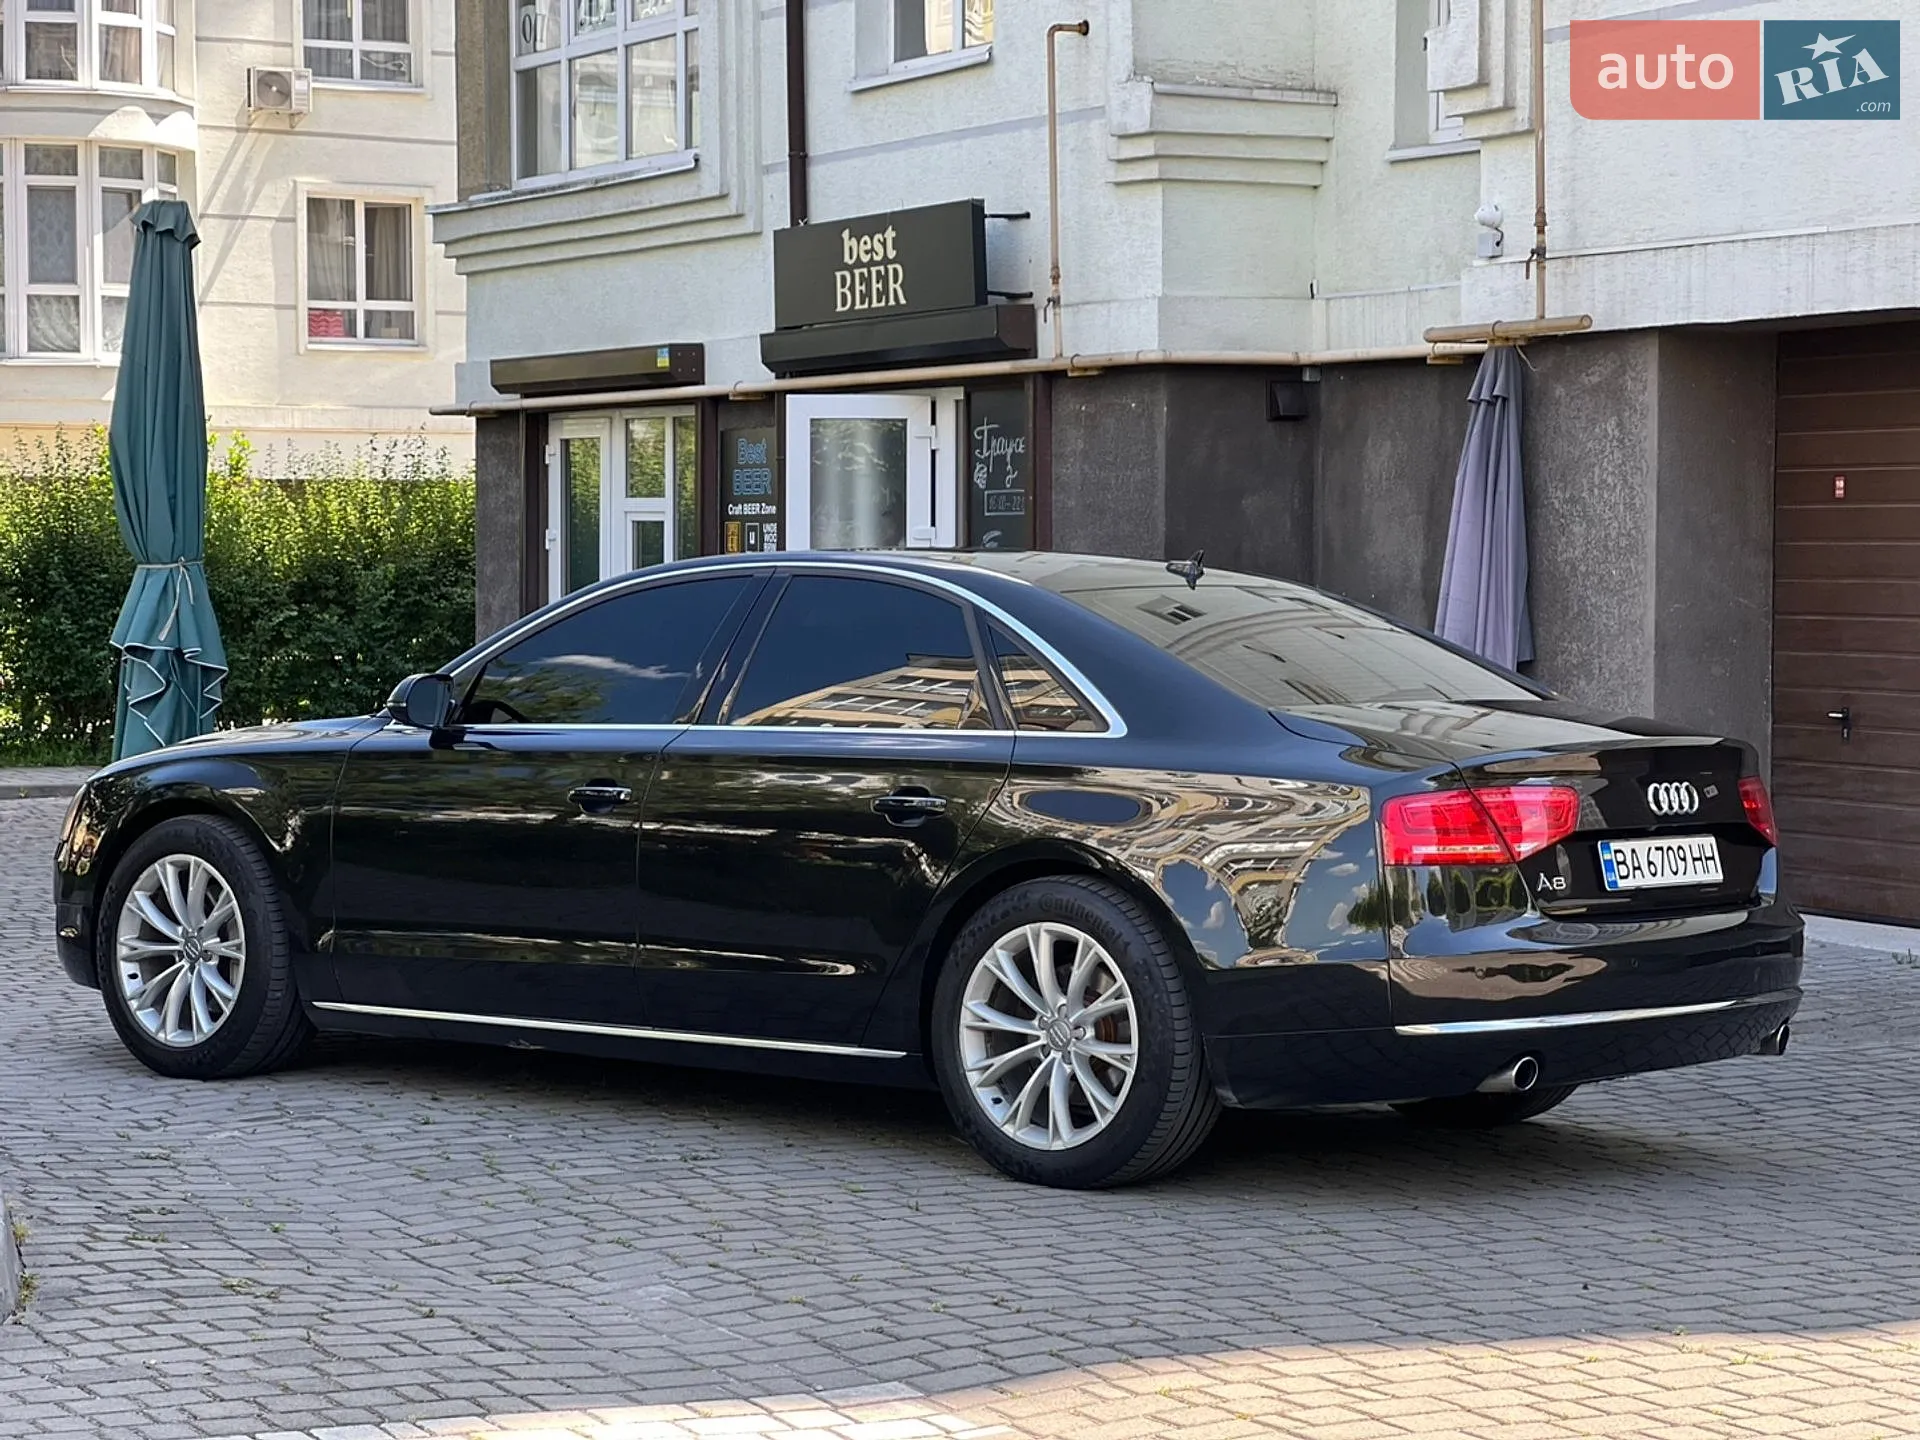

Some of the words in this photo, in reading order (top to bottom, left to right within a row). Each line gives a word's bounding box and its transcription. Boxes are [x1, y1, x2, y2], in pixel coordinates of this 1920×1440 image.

[841, 225, 897, 264] best
[834, 263, 907, 312] BEER
[733, 468, 772, 495] BEER
[727, 503, 743, 515] Craft
[743, 502, 760, 515] BEER
[761, 502, 777, 515] Zone
[1537, 872, 1566, 892] A8
